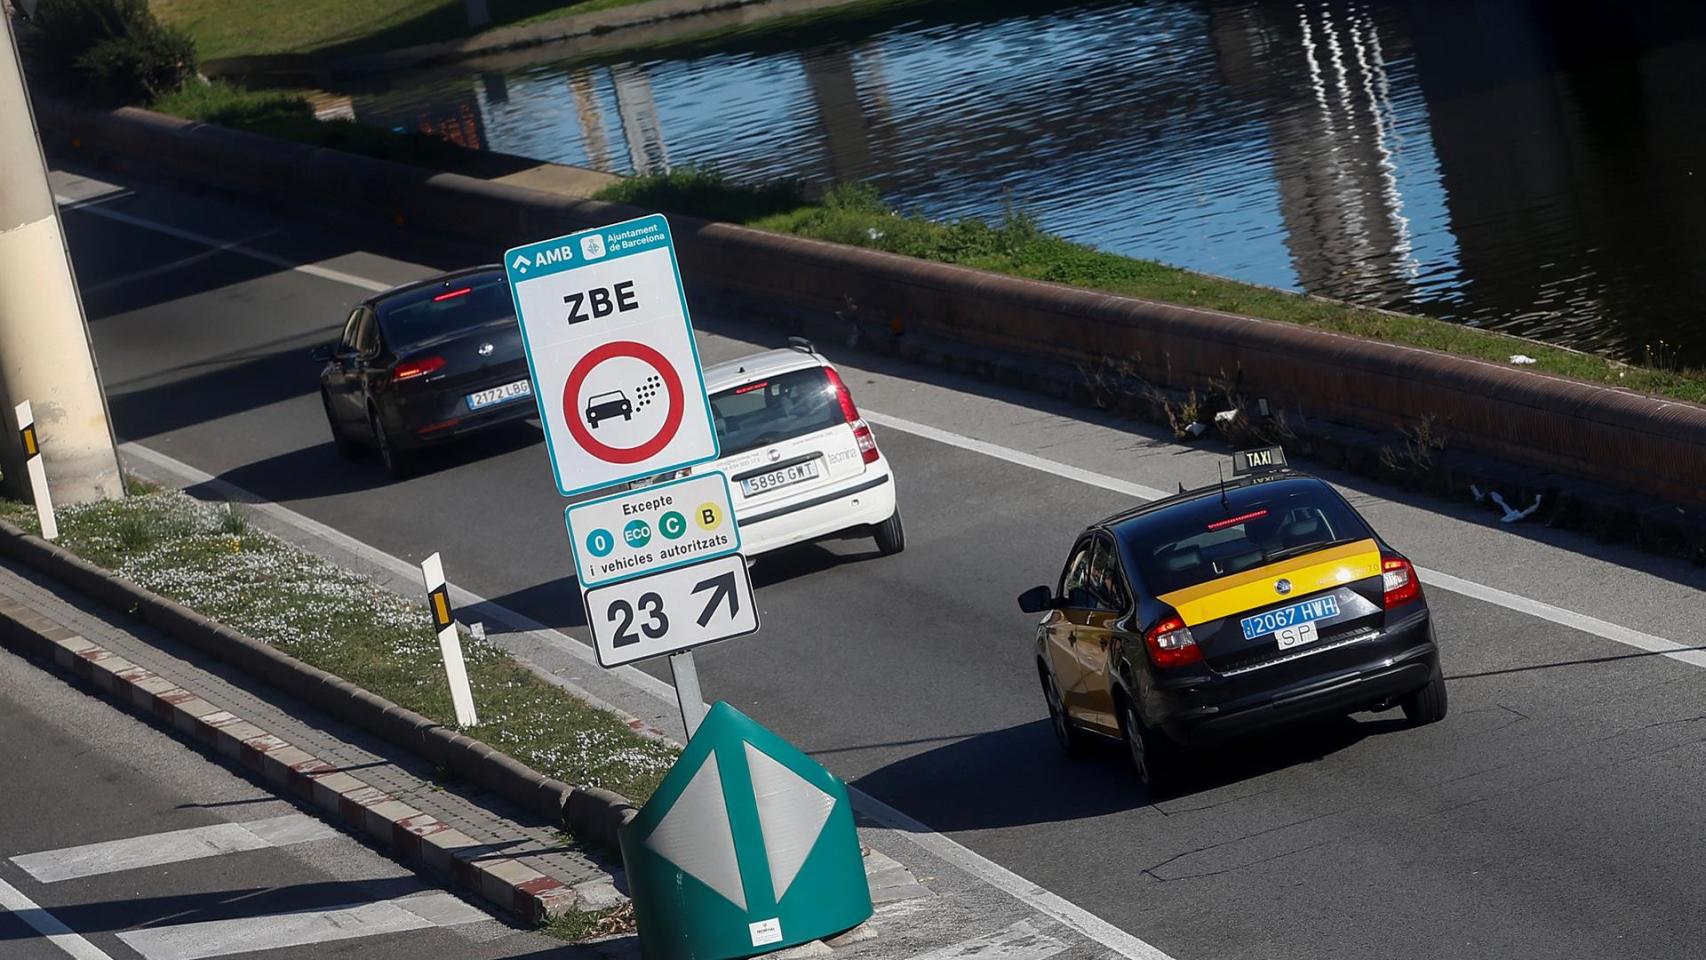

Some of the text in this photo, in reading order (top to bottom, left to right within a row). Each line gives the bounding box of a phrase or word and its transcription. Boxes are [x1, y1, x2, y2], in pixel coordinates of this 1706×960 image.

[607, 224, 658, 243] Ajuntament
[609, 232, 665, 252] de Barcelona
[535, 246, 573, 267] AMB
[563, 280, 639, 325] ZBE
[474, 381, 528, 405] 2172 LBG
[1246, 450, 1272, 467] TAXI
[750, 463, 813, 491] 5896 GWT
[622, 495, 673, 515] Excepte
[625, 526, 650, 542] ECO
[666, 517, 680, 533] C
[702, 508, 715, 525] B
[590, 534, 728, 576] i vehicles autoritzats
[607, 592, 669, 648] 23
[1253, 597, 1336, 634] 2067 HWH
